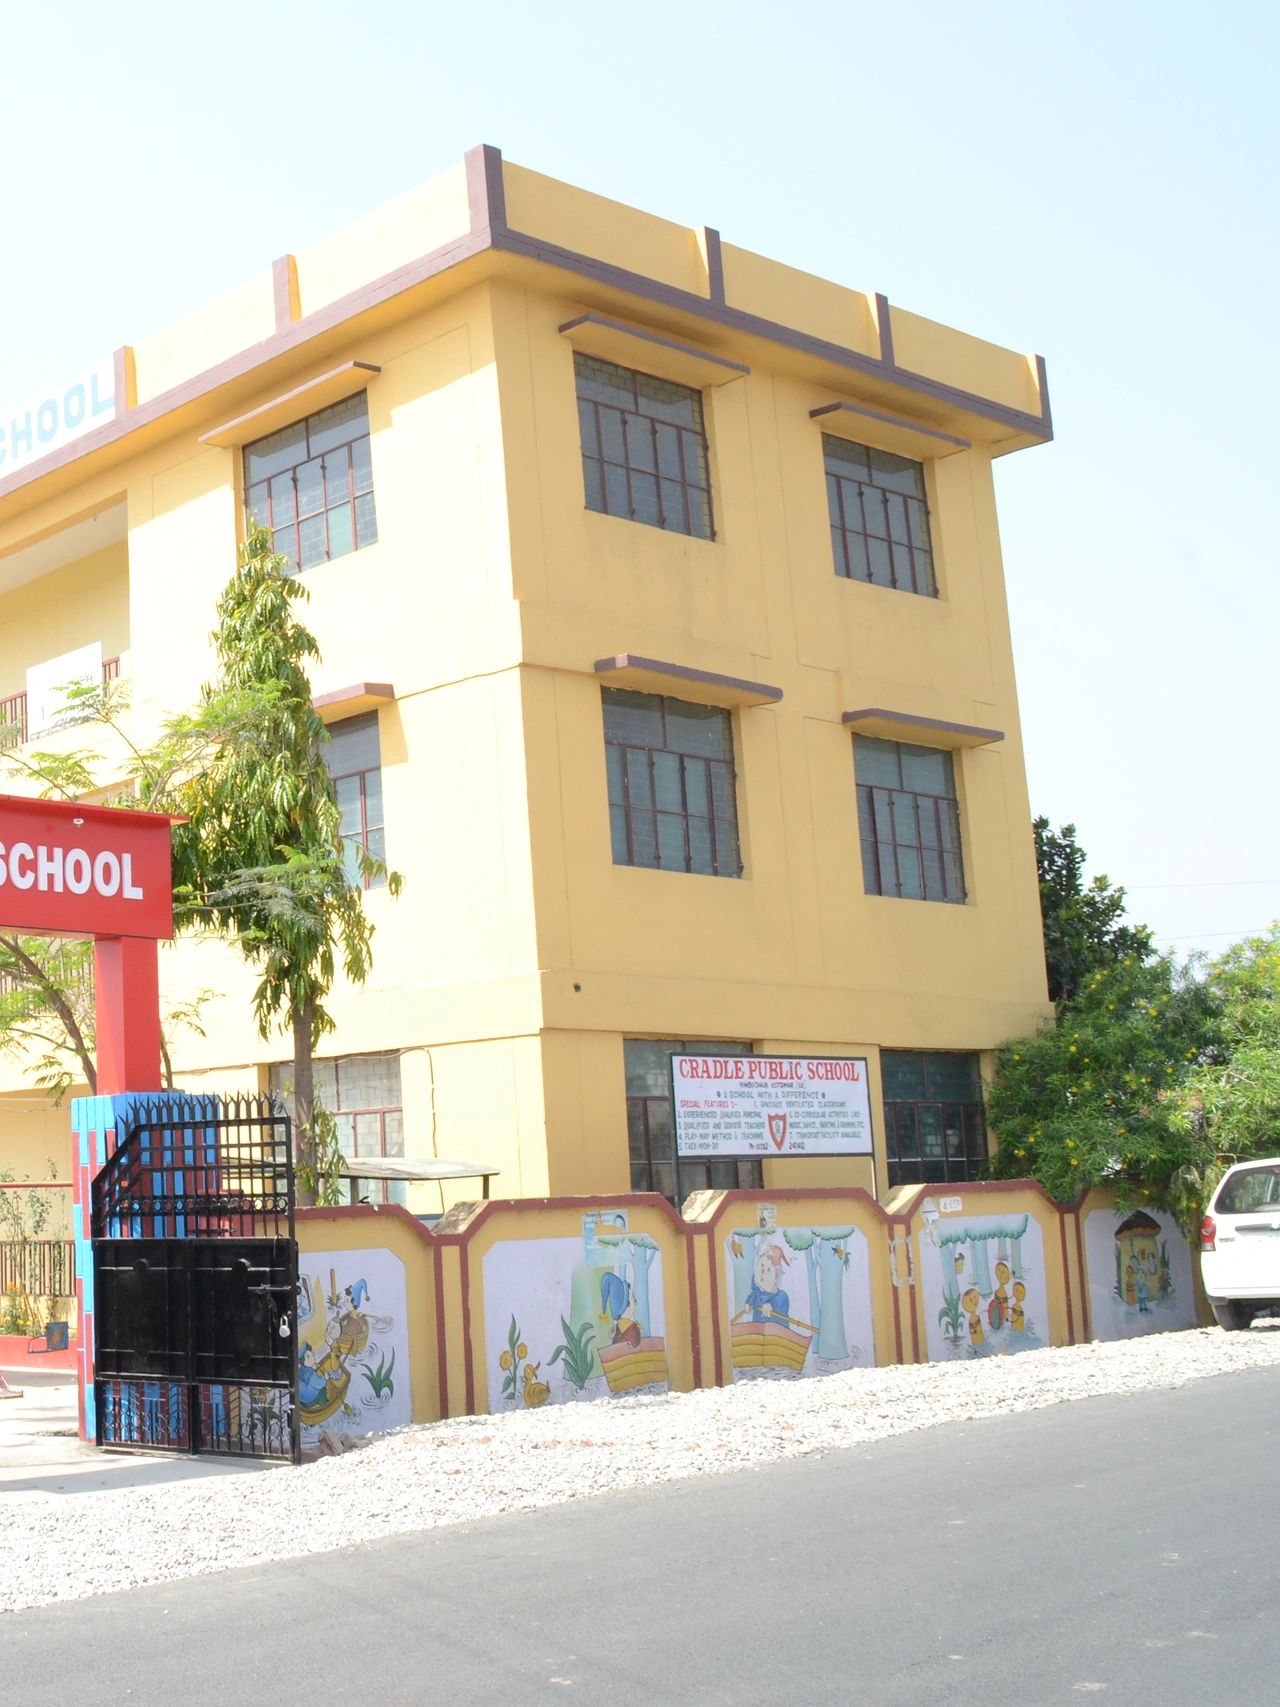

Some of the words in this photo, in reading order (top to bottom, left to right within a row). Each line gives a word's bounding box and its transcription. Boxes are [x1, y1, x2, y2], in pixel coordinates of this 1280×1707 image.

[680, 1059, 744, 1080] CRADLE
[747, 1060, 803, 1081] PUBLIC
[807, 1061, 860, 1082] SCHOOL
[730, 1091, 754, 1099] SCHOOL
[758, 1091, 772, 1099] WITH
[782, 1091, 819, 1100] DIFFERENCE
